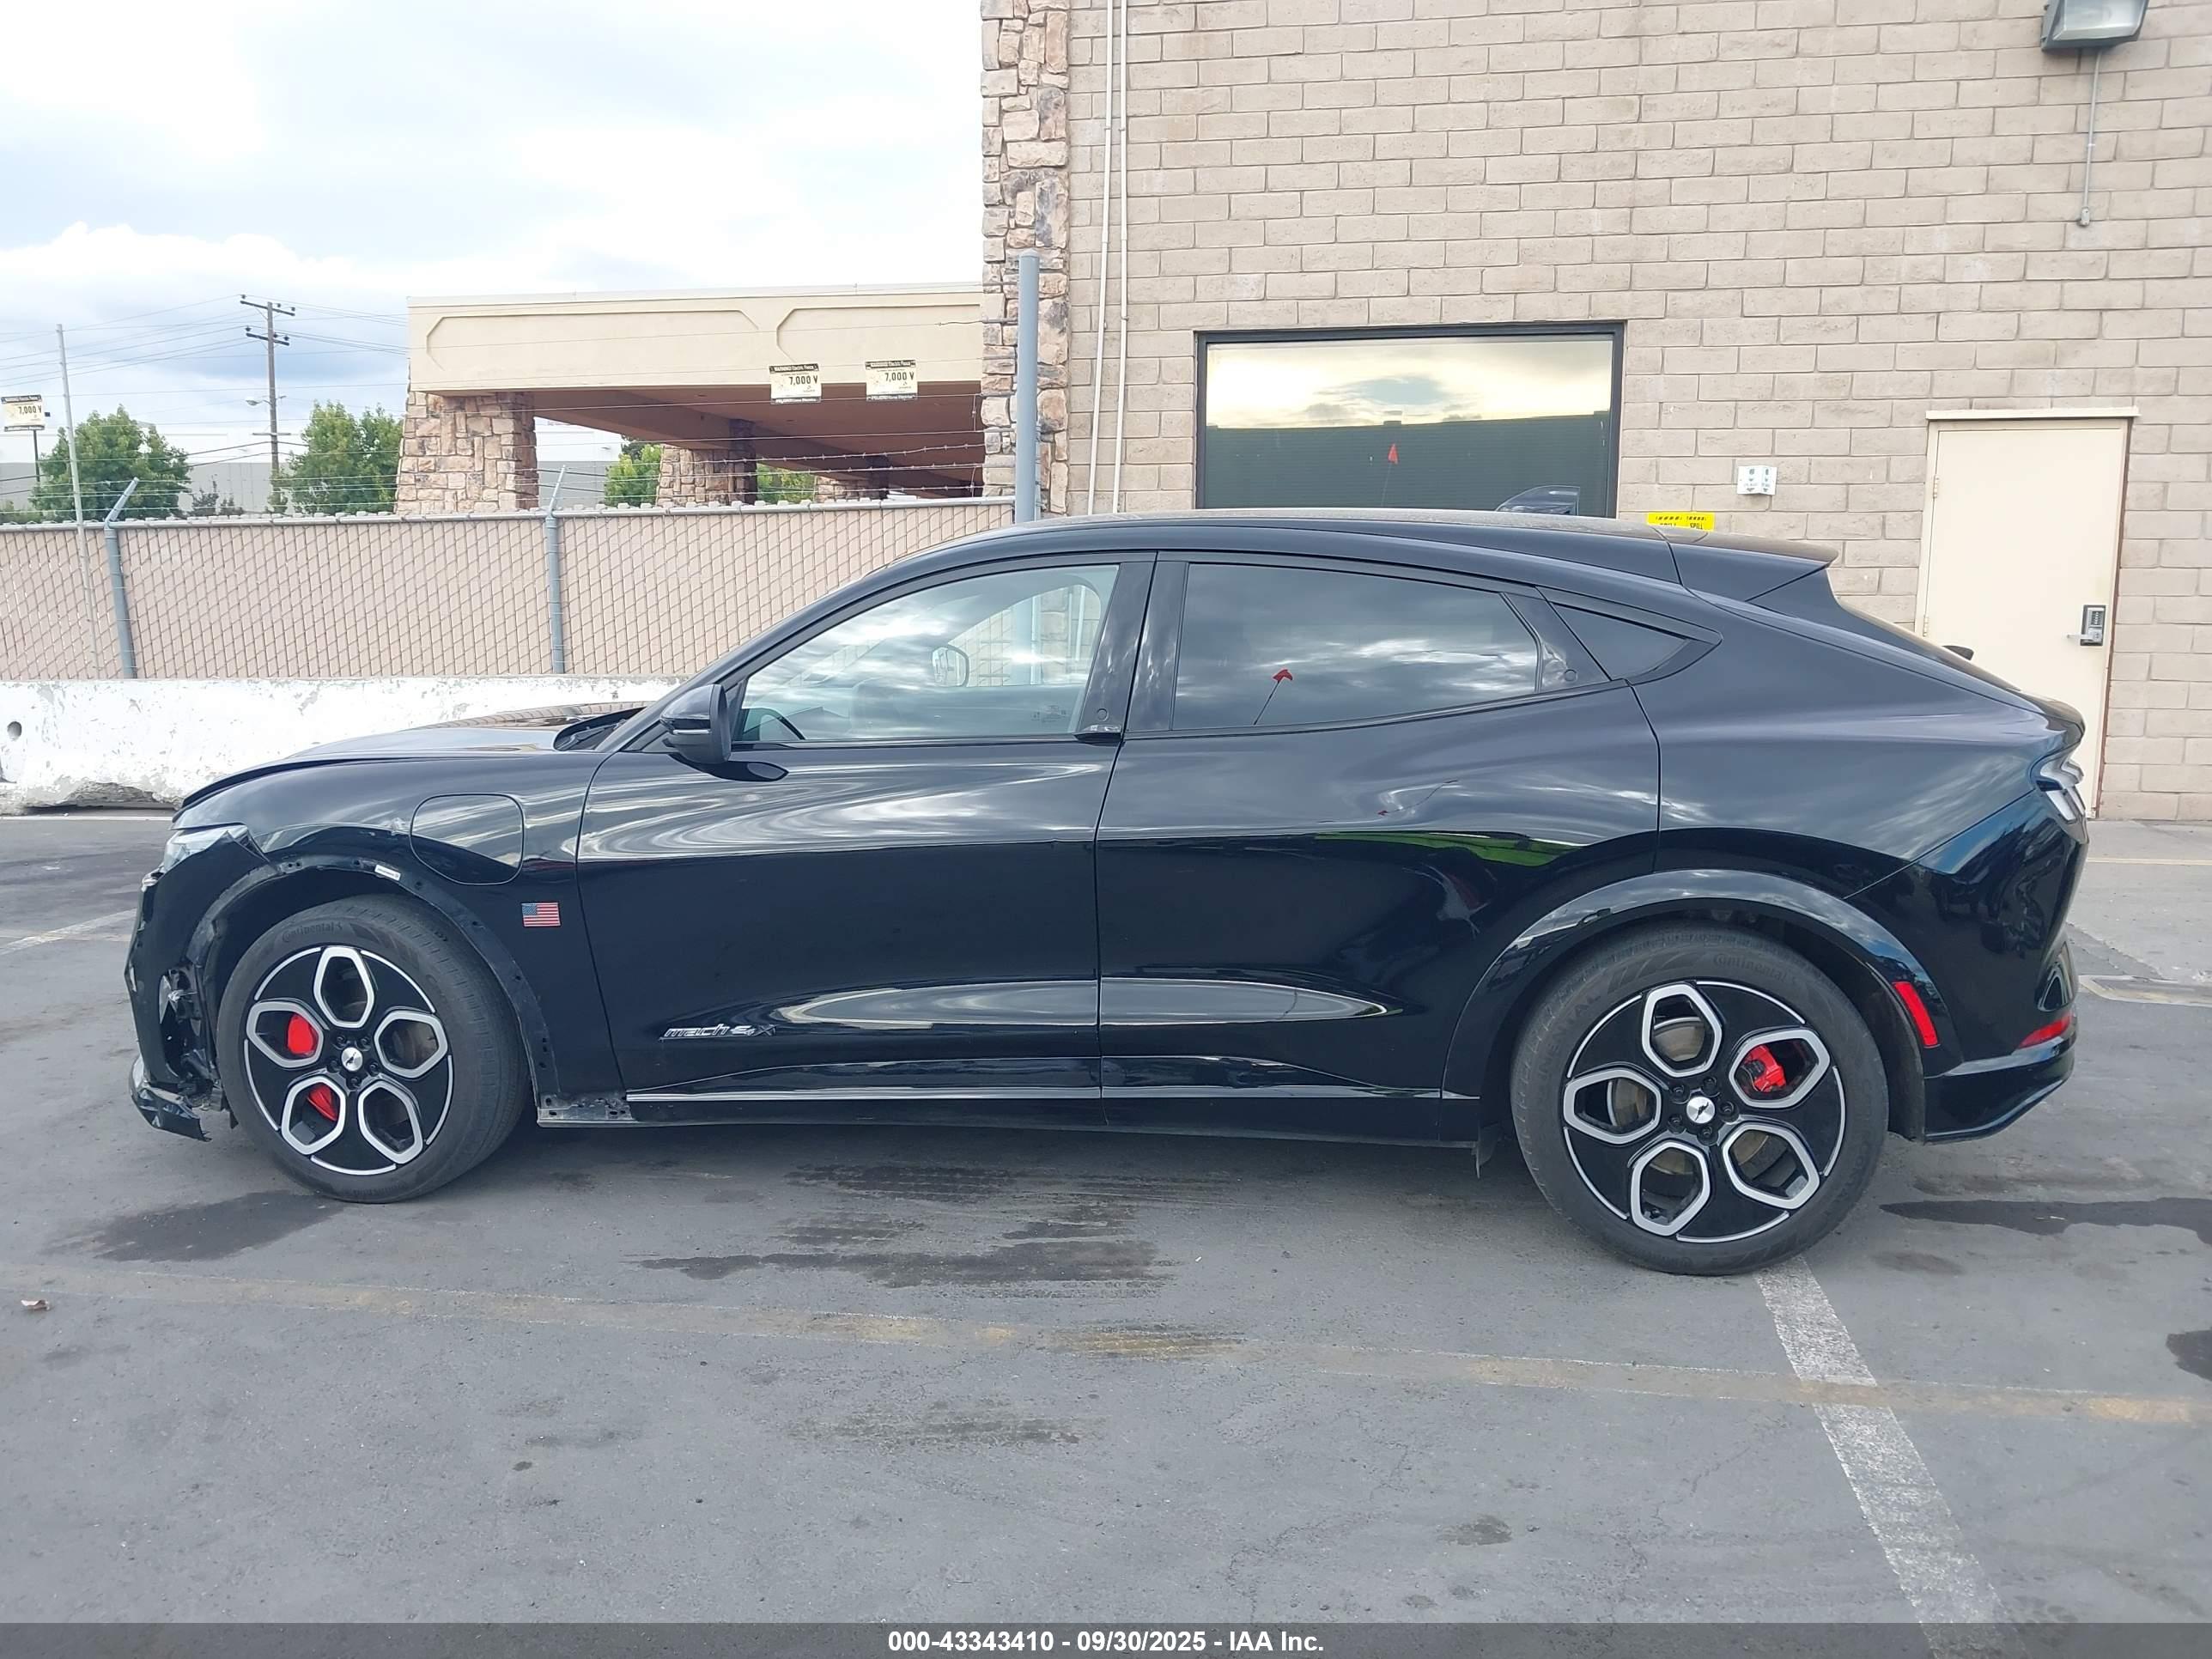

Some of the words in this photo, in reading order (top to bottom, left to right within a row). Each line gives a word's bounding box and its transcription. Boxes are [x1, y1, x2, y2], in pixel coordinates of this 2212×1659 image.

[788, 375, 811, 386] 7,000
[812, 374, 818, 385] V
[884, 372, 907, 382] 7,000
[908, 371, 915, 381] V
[17, 405, 37, 415] 7,000
